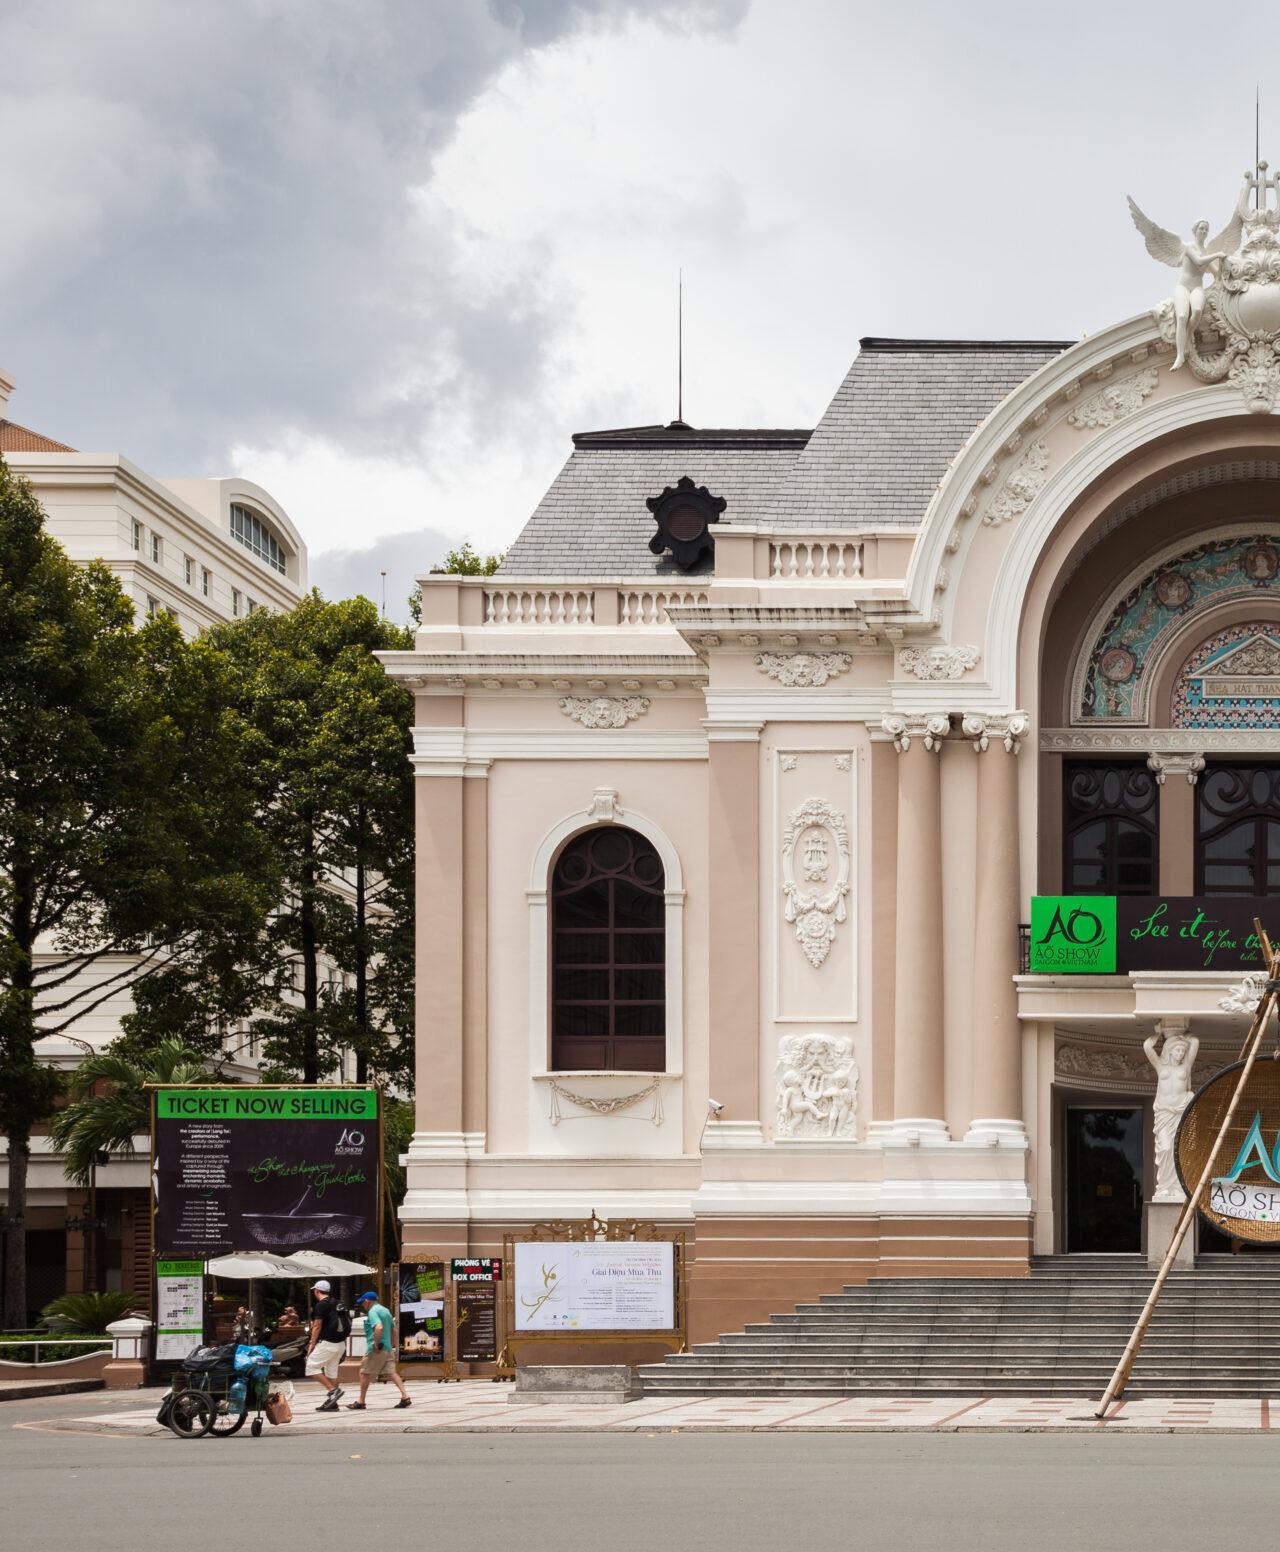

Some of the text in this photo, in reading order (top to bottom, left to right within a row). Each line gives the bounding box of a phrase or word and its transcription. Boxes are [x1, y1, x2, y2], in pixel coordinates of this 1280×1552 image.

[1130, 903, 1218, 940] See it
[1058, 947, 1102, 960] SHOW
[1202, 929, 1237, 967] before
[168, 1098, 367, 1114] TICKET NOW SELLING
[1212, 1202, 1257, 1220] SAIGON
[452, 1273, 493, 1281] BOX OFFICE
[645, 1267, 662, 1276] Thu
